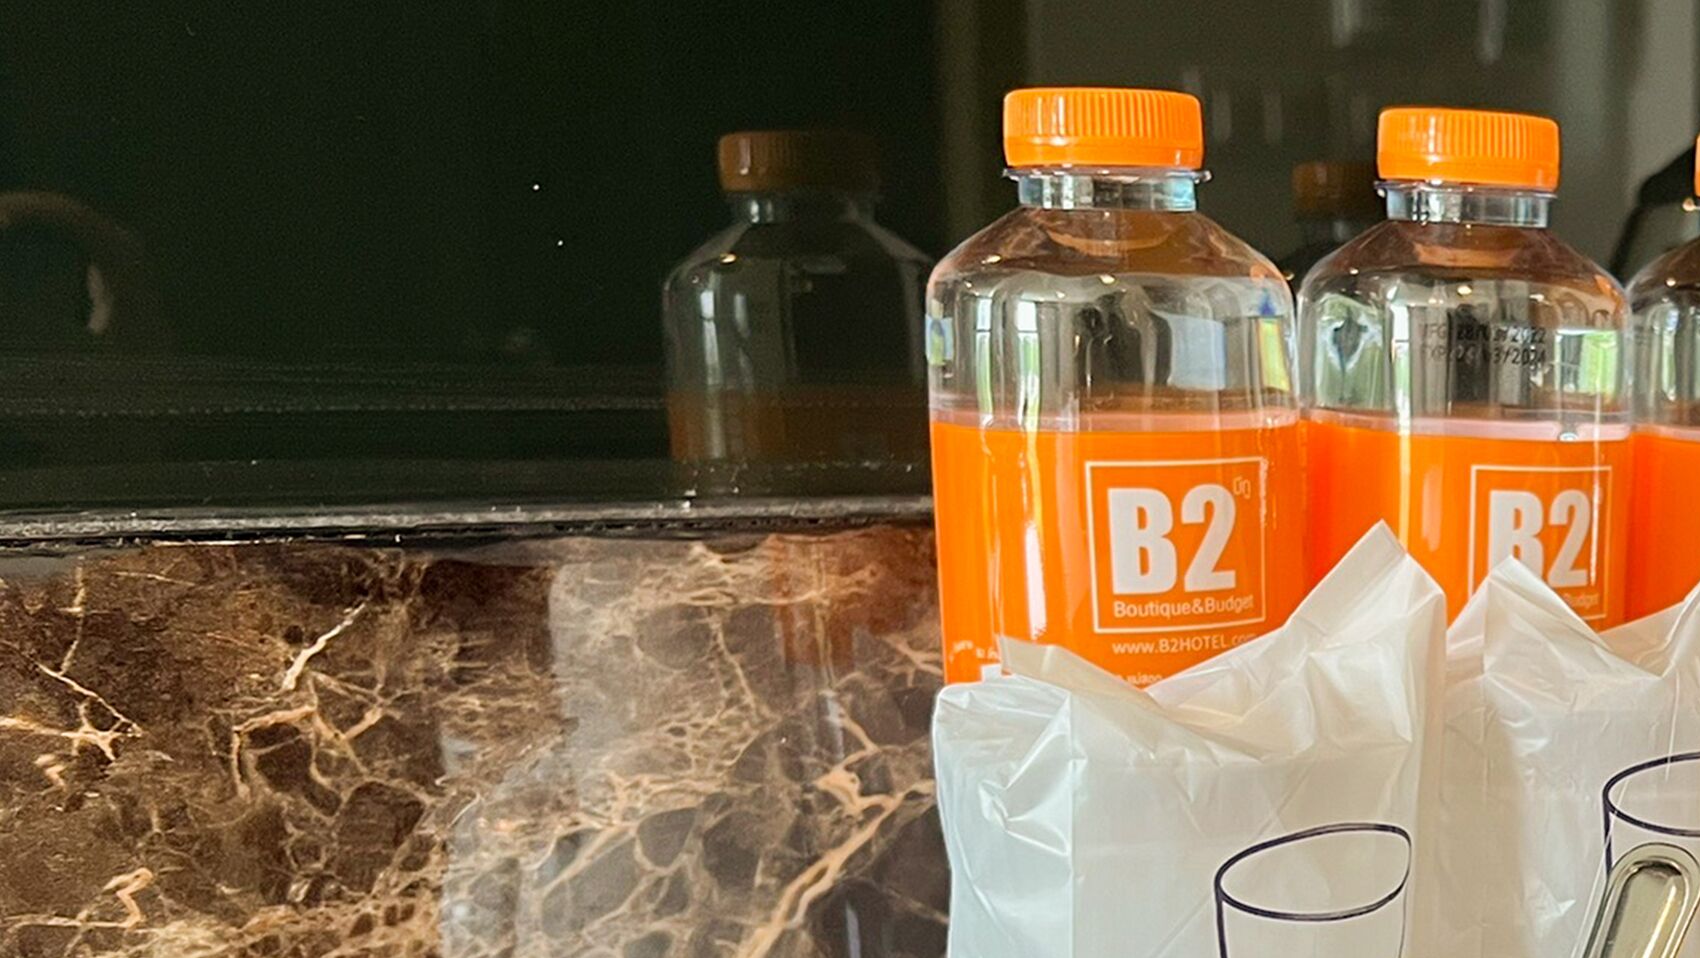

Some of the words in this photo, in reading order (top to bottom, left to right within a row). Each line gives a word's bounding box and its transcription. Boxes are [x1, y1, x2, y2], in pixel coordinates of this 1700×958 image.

[1107, 484, 1236, 595] B2
[1488, 489, 1591, 588] B2
[1113, 595, 1255, 620] Boutique&Budget
